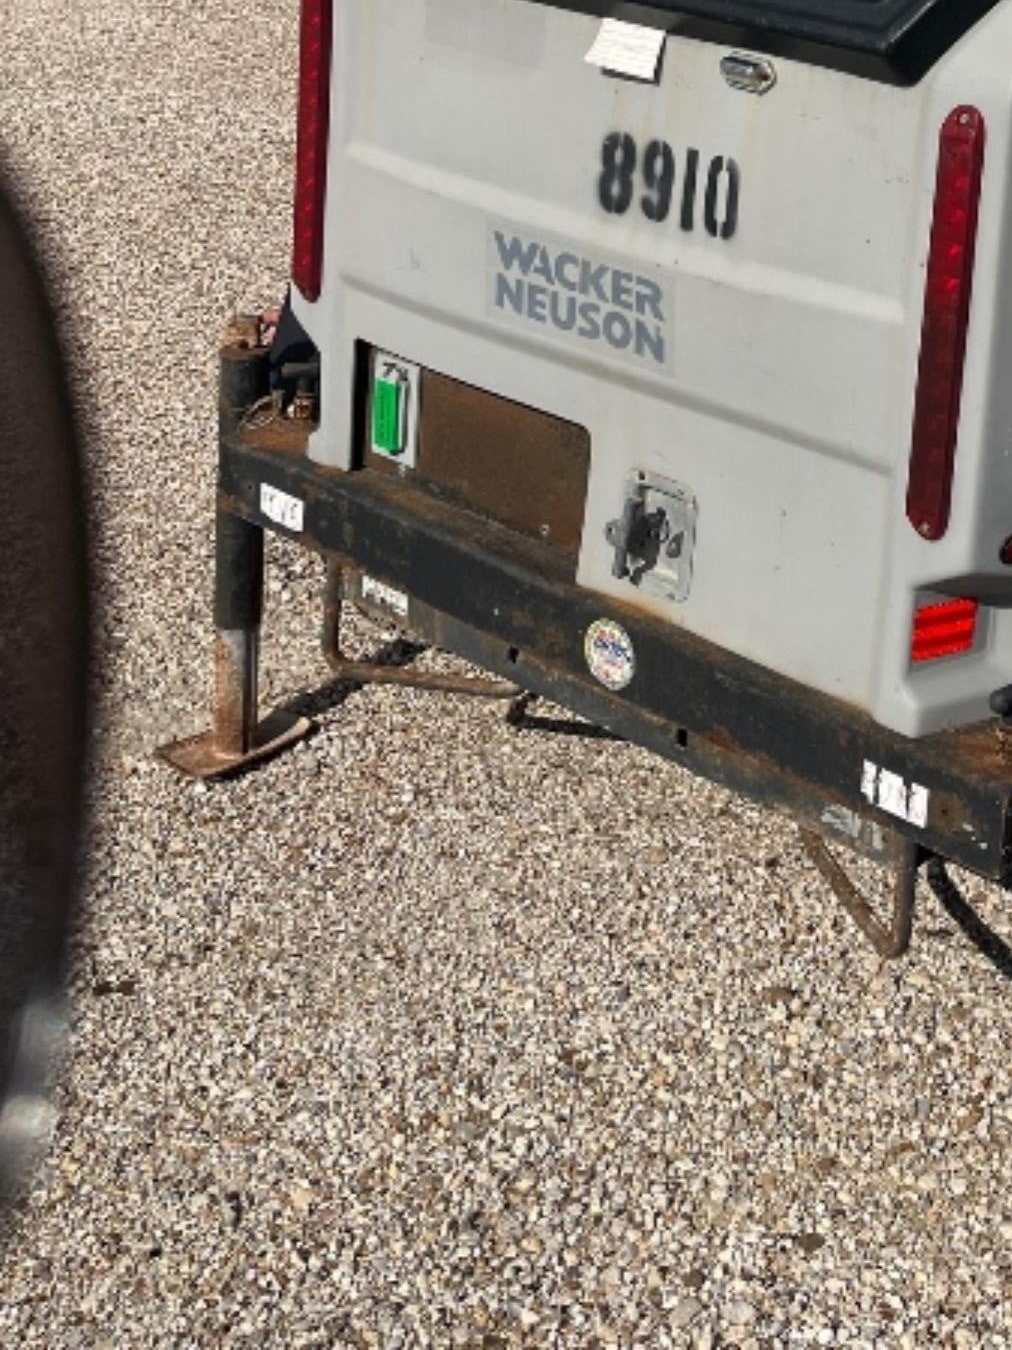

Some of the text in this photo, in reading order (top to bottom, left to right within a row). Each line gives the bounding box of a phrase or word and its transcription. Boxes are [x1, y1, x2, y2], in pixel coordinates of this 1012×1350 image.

[598, 131, 740, 240] 8910
[494, 230, 665, 322] WACKER
[495, 272, 665, 364] NEUSON
